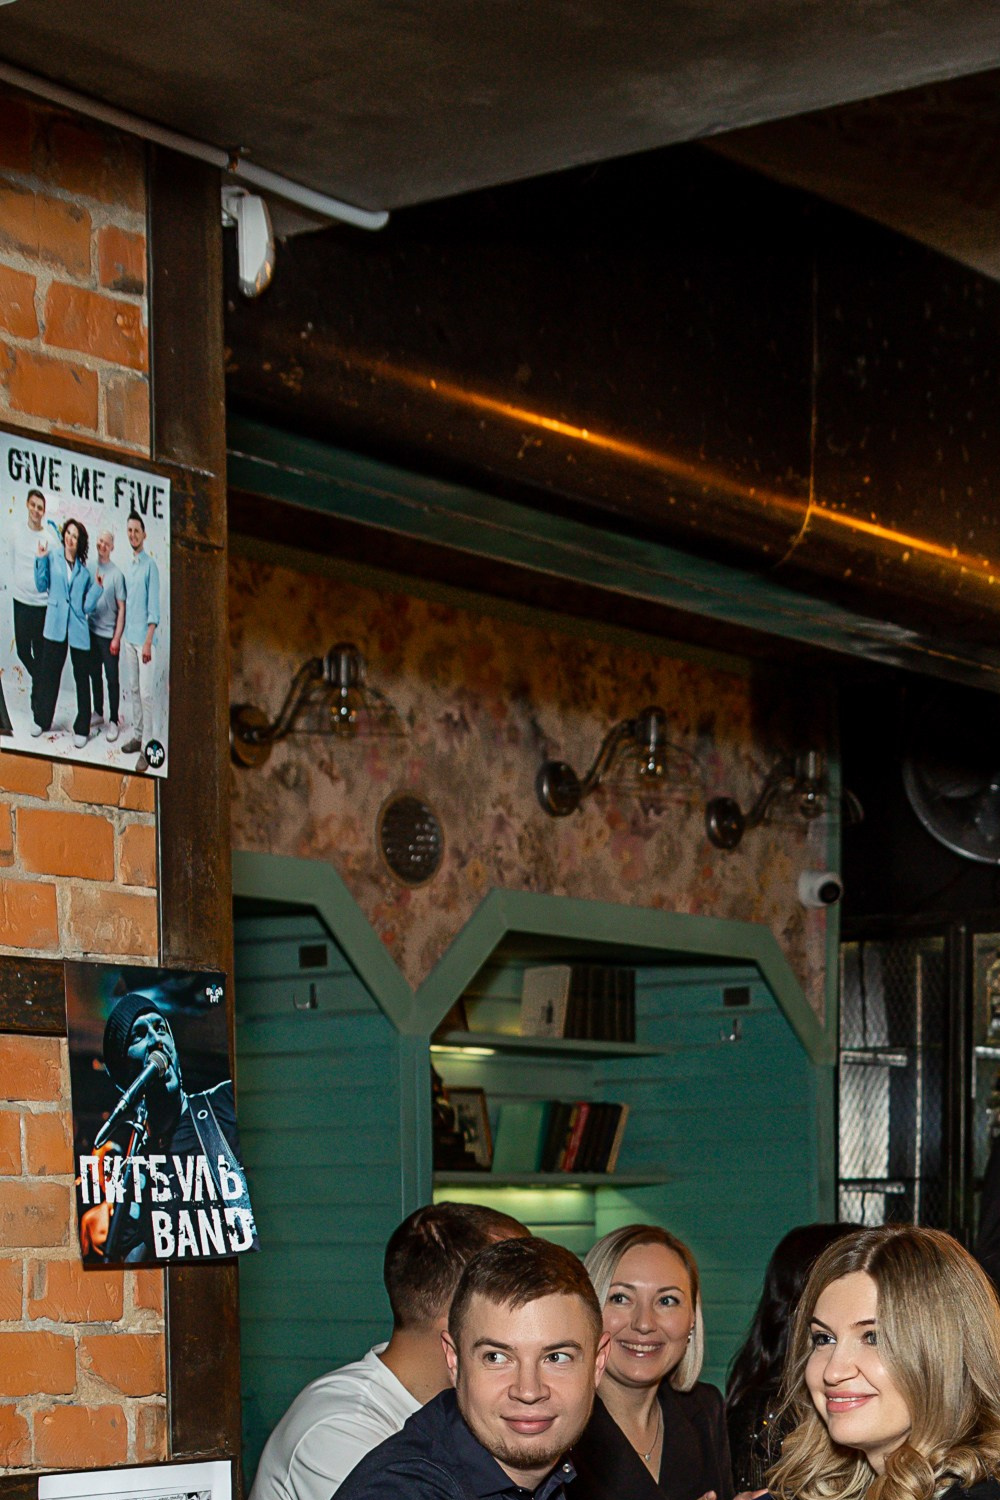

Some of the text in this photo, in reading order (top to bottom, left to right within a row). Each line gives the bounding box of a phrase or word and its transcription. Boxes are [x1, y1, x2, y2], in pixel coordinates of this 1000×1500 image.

[71, 463, 106, 504] ME
[79, 1154, 244, 1204] ПИТБУЛЬ
[152, 1208, 254, 1258] BAND
